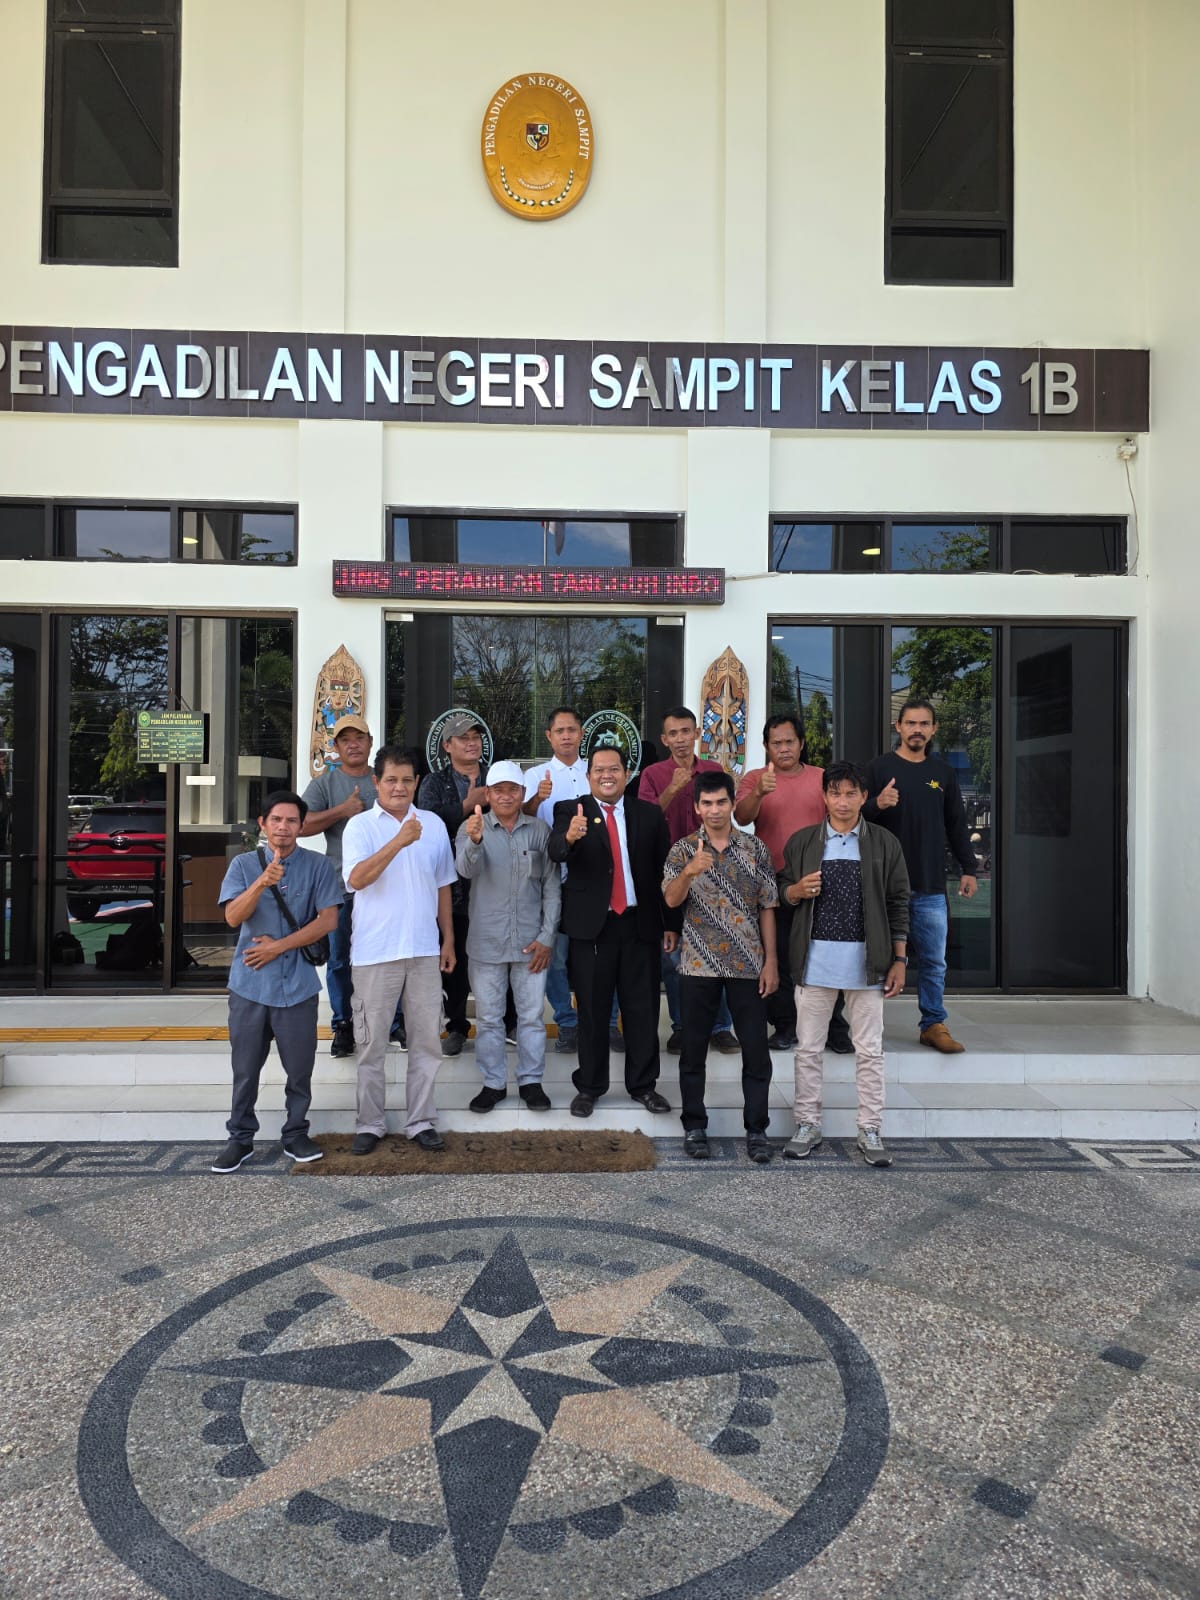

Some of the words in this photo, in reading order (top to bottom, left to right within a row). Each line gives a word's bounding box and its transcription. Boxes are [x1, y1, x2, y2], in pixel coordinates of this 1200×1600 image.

[485, 80, 522, 157] PENGADILAN
[528, 76, 577, 104] NEGERI
[575, 108, 590, 160] SAMPIT
[0, 340, 343, 402] ENGADILAN
[366, 347, 564, 409] NEGERI
[589, 354, 793, 411] SAMPIT
[821, 359, 1002, 415] KELAS
[1020, 361, 1079, 415] 1B
[481, 732, 489, 756] AMPIT
[580, 715, 604, 756] PENGADILAN
[606, 714, 631, 730] NEGERI
[628, 730, 638, 757] SAMPIT
